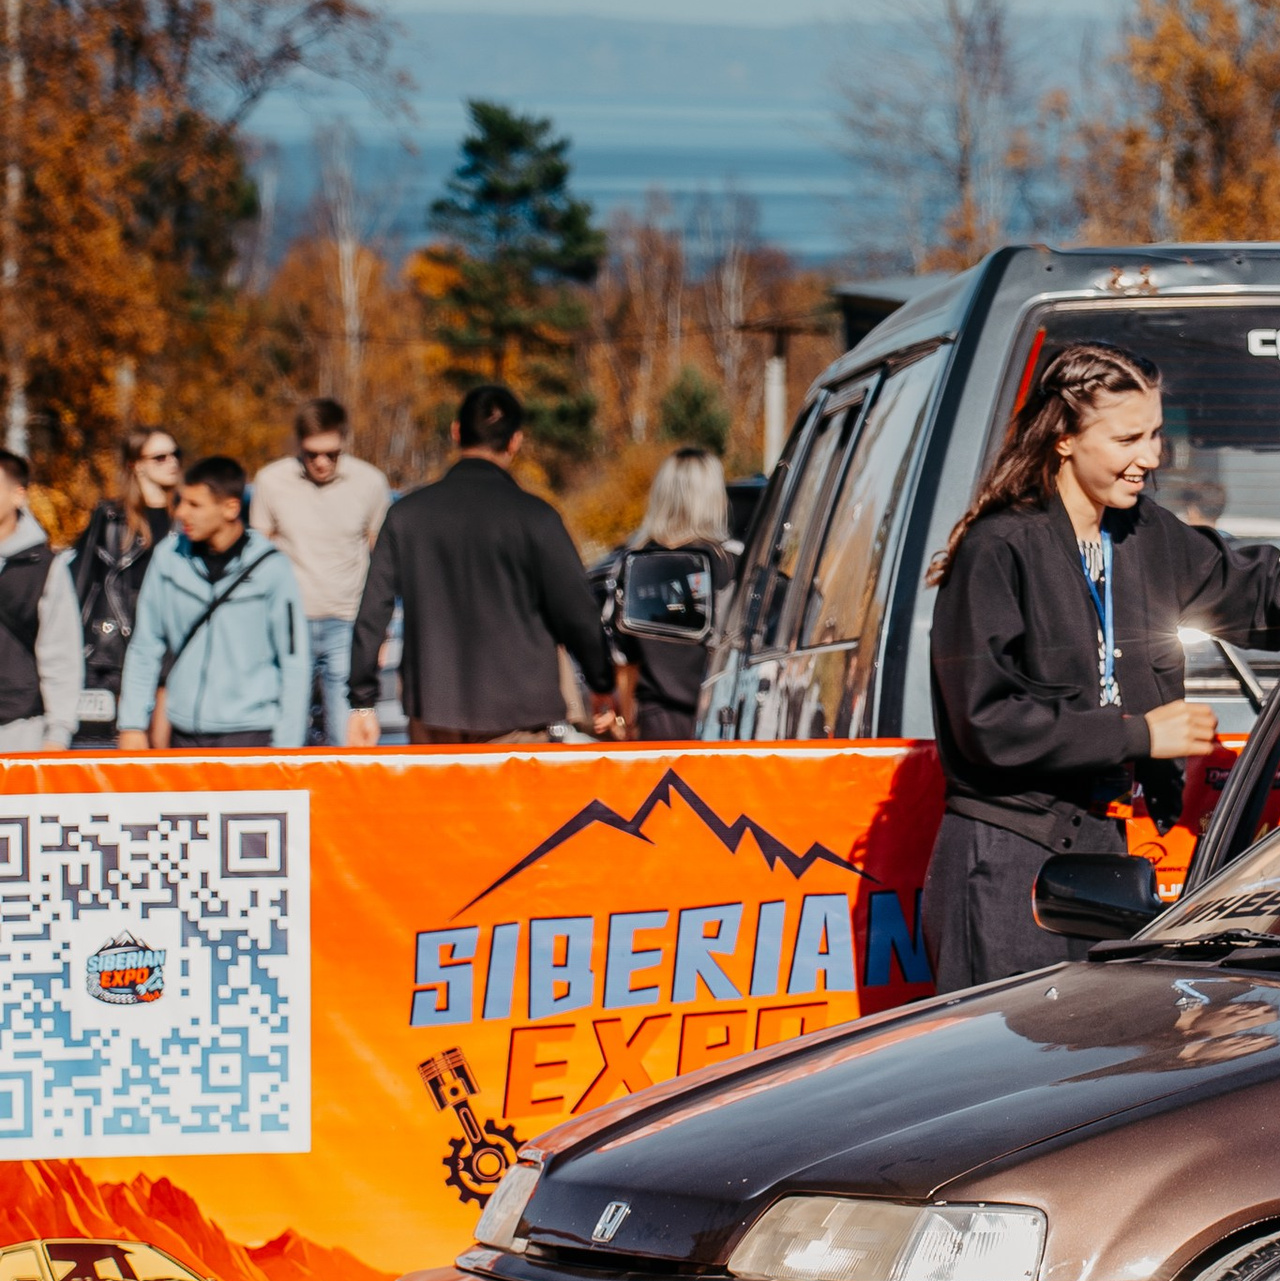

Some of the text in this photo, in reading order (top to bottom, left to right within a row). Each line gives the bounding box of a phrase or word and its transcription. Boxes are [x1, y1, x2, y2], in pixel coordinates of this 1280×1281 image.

[87, 950, 166, 973] SIBERIAN
[410, 890, 935, 1026] SIBERIAN
[100, 967, 149, 988] EXPO
